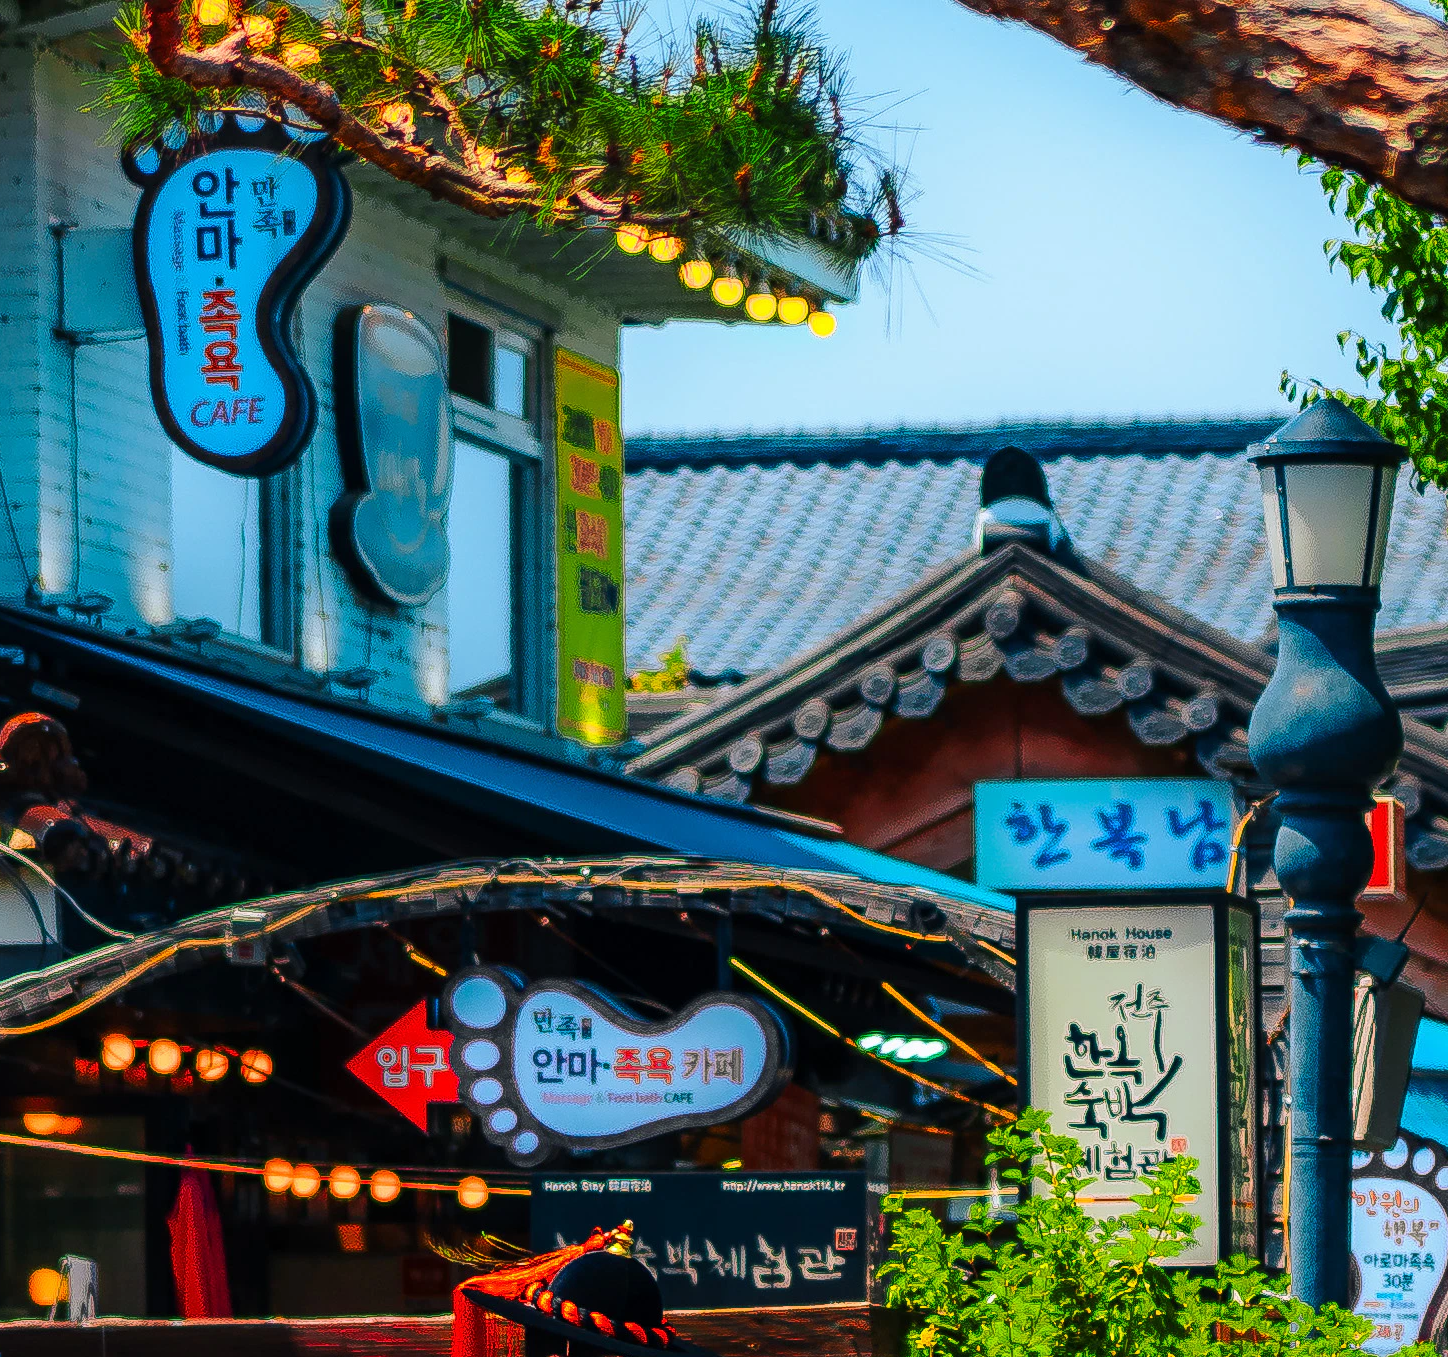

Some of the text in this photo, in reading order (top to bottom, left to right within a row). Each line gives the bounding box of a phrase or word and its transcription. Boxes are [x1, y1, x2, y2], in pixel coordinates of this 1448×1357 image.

[191, 397, 264, 426] CAFE
[1004, 801, 1229, 872] 한복남
[1071, 924, 1173, 941] Hanok House
[376, 1046, 447, 1087] 입구
[680, 1049, 744, 1085] 카페
[663, 1092, 694, 1104] CAFE
[544, 1181, 578, 1192] Hanok
[581, 1181, 605, 1193] Stay
[1363, 1253, 1435, 1272] 아로마족욕
[1382, 1272, 1414, 1292] 30분
